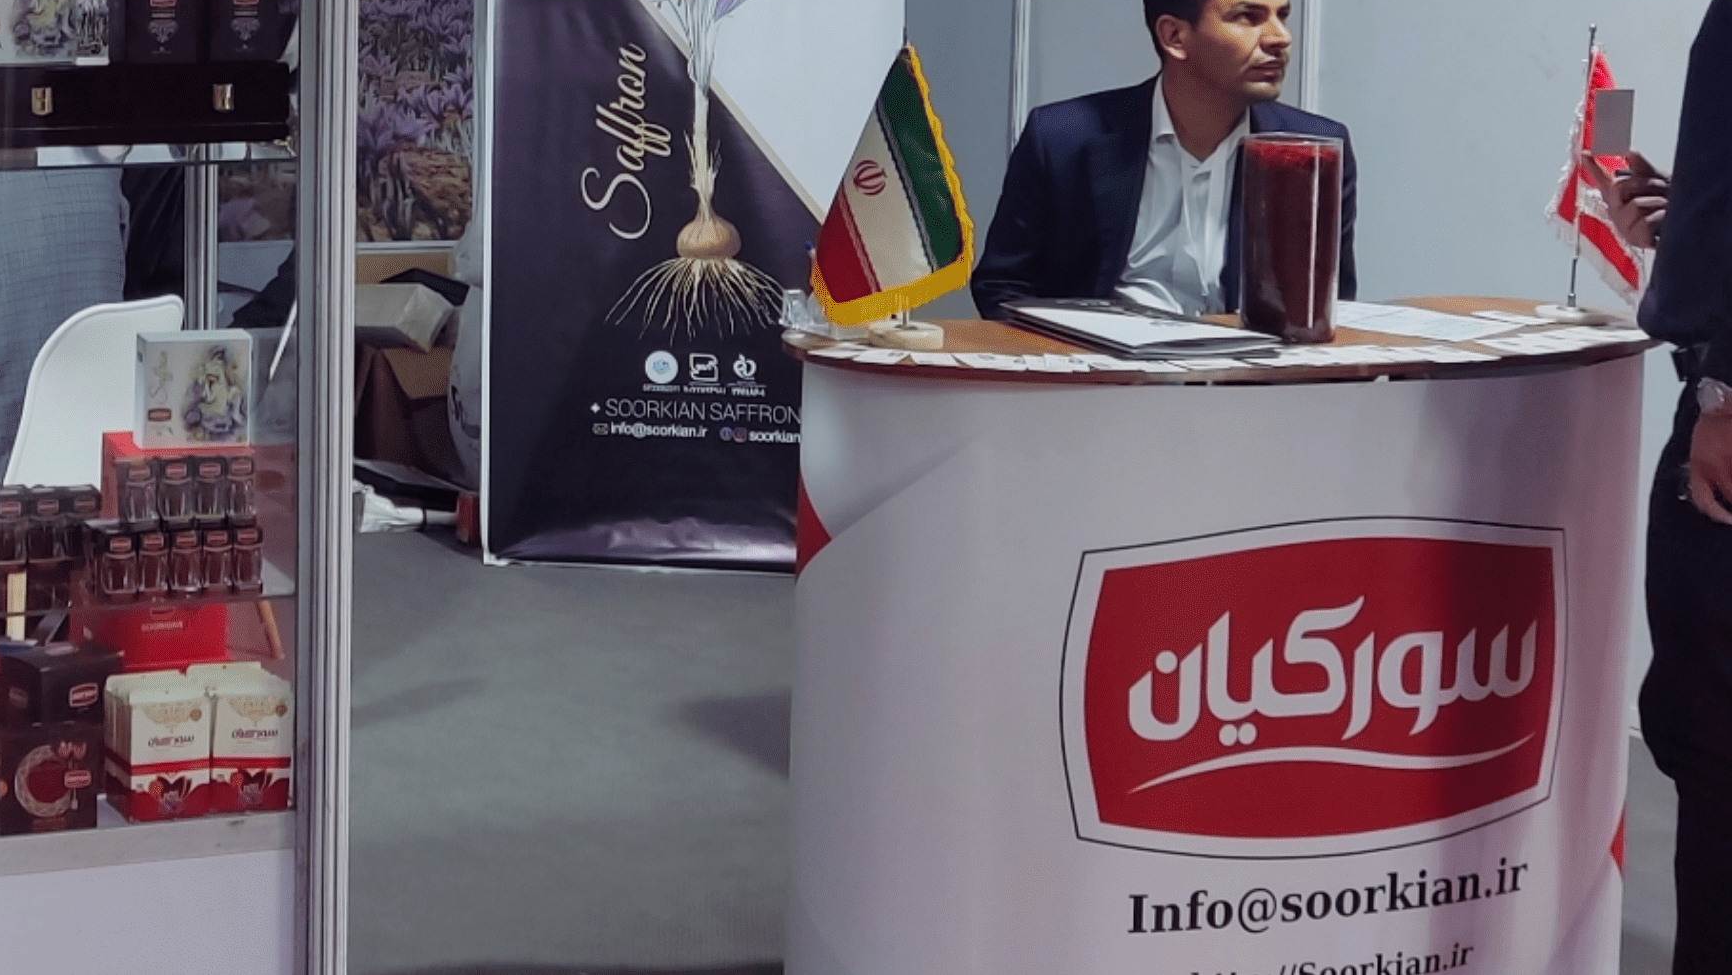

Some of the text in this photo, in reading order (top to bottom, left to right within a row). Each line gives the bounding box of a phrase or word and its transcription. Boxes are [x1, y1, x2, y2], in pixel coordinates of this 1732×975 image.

[580, 43, 672, 239] Saffron
[605, 398, 802, 425] SOORKIAN SAFFRON
[1128, 595, 1537, 746] سورکیان
[1127, 857, 1529, 934] Info@soorkian.ir
